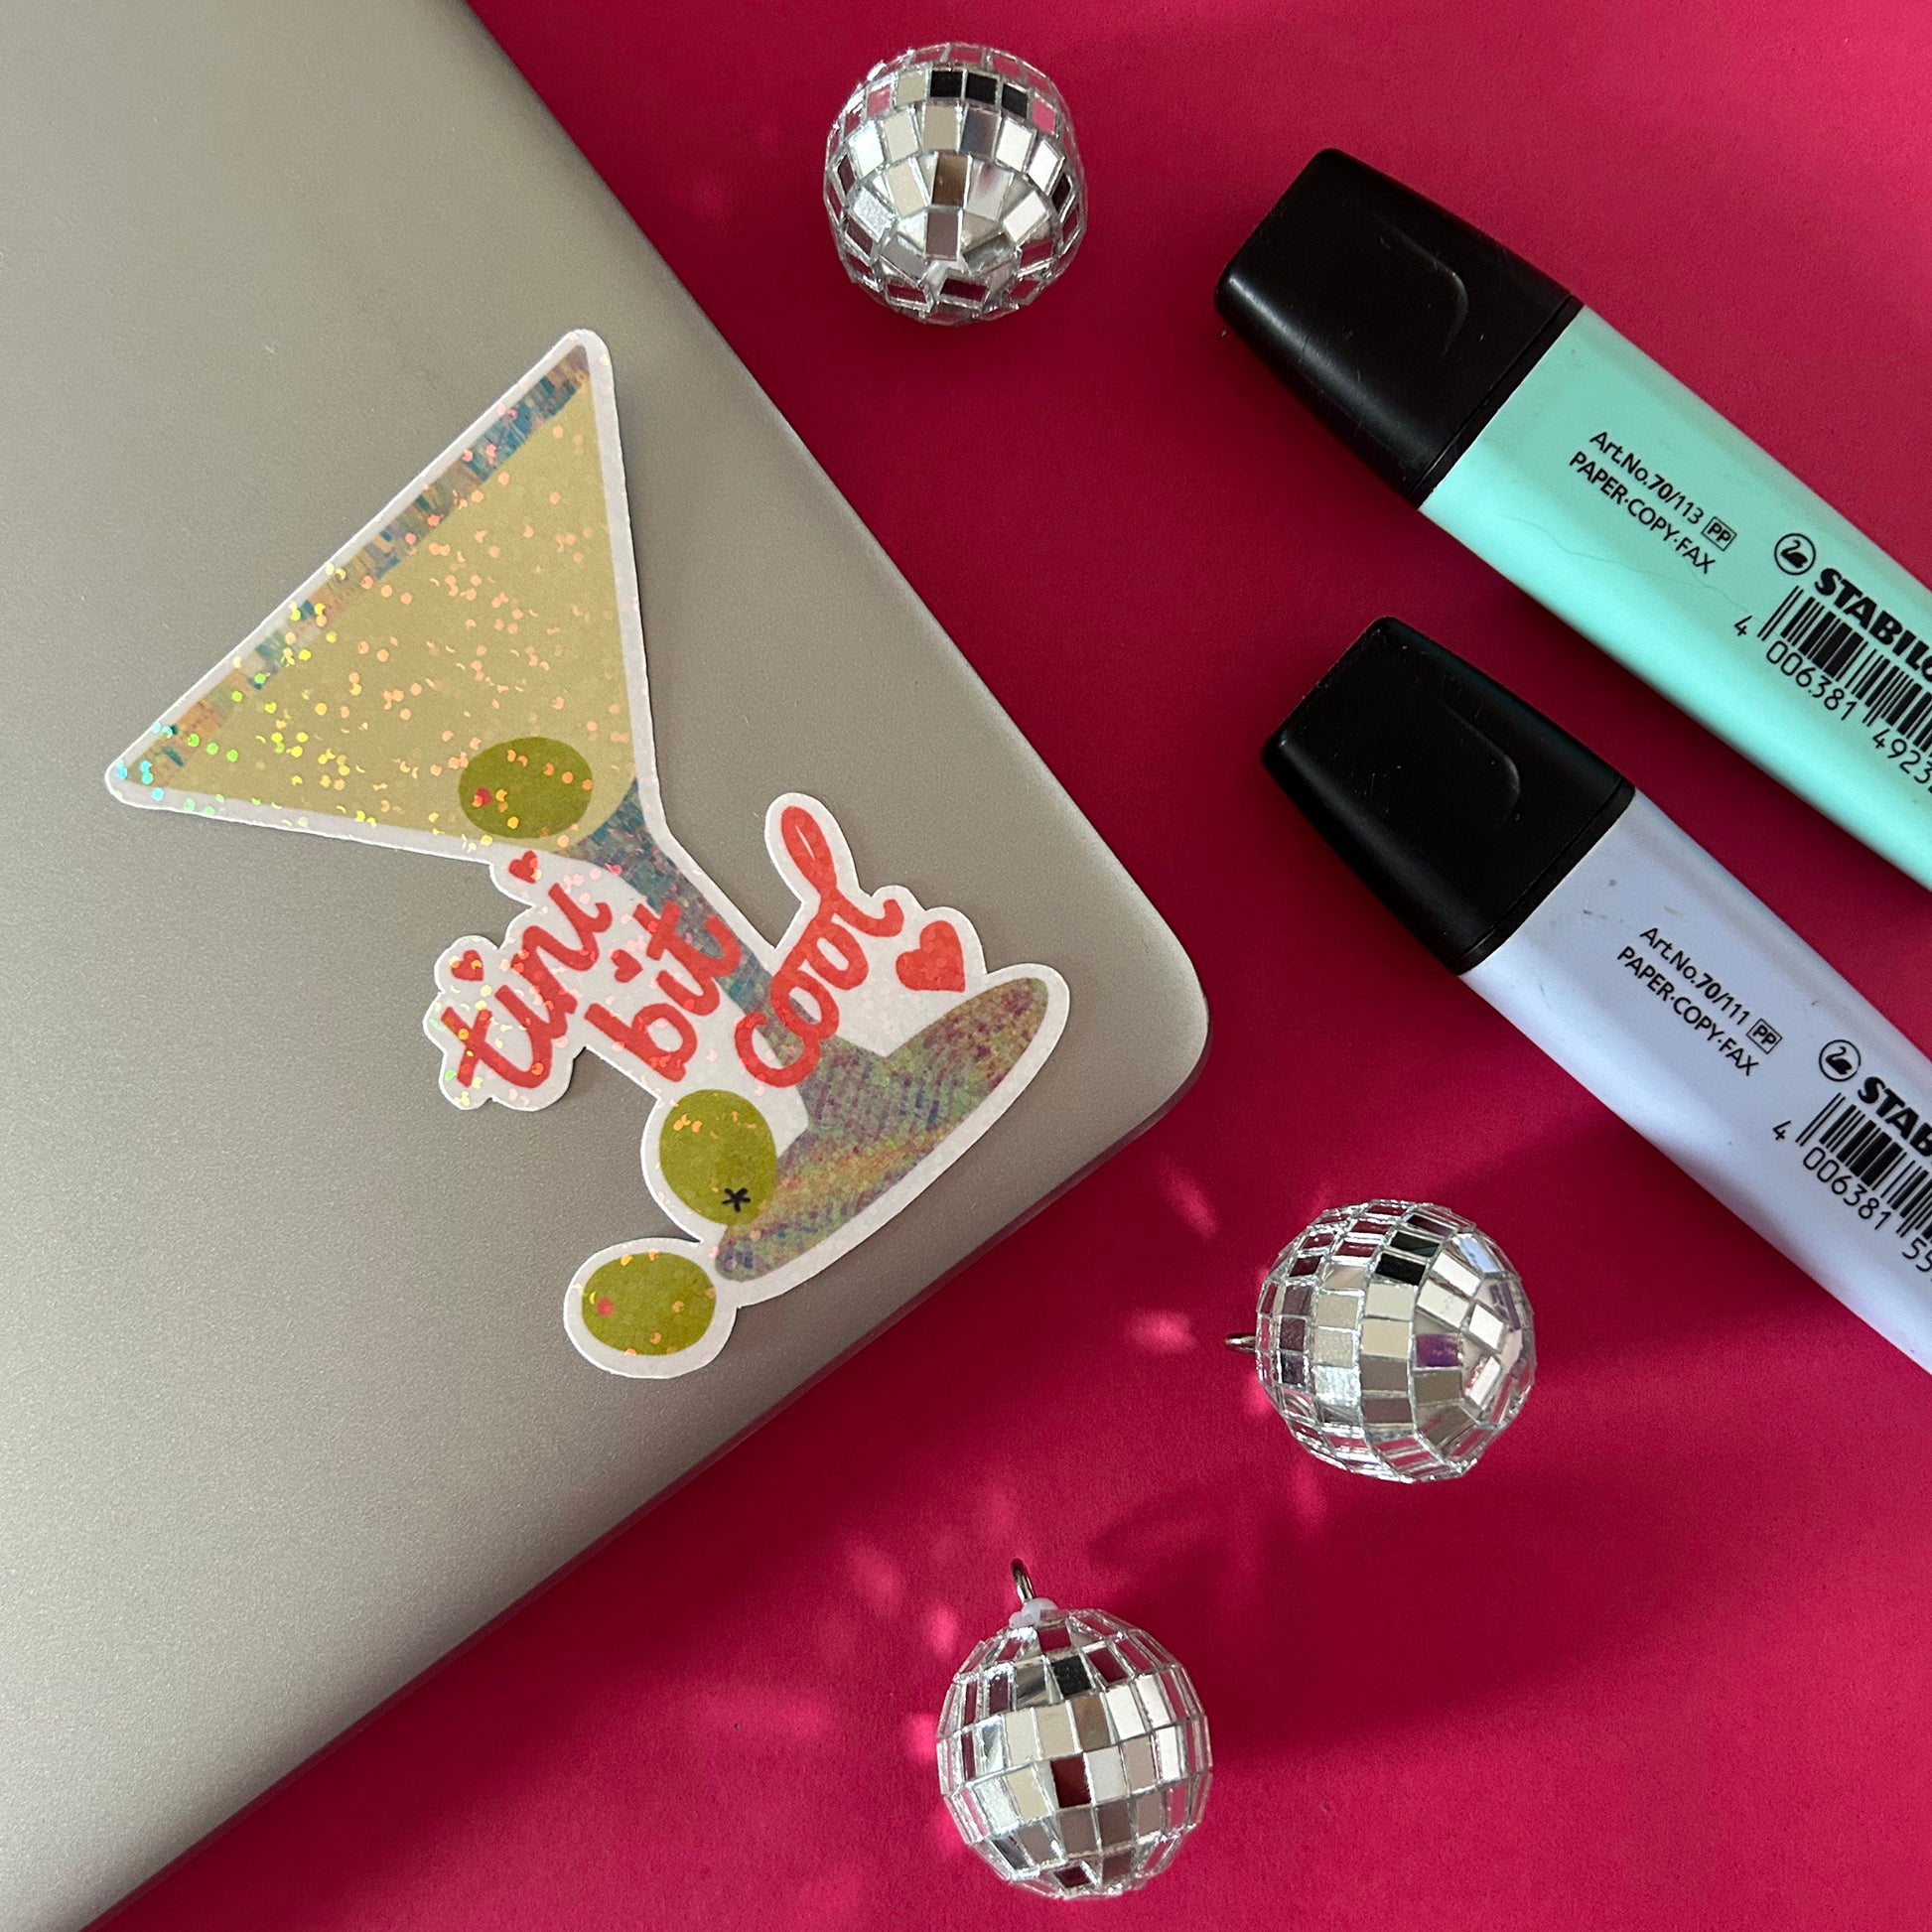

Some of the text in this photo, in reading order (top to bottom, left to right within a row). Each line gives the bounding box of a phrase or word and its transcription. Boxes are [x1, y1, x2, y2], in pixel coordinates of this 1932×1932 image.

[1706, 521, 1733, 544] PP
[1733, 615, 1932, 793] 4 006381 4923
[441, 851, 613, 1089] tini
[584, 900, 742, 1082] bit
[734, 806, 904, 1088] cool
[1751, 1024, 1778, 1046] PP
[1772, 1120, 1932, 1282] 4 006381 55
[1857, 1076, 1932, 1167] STAB
